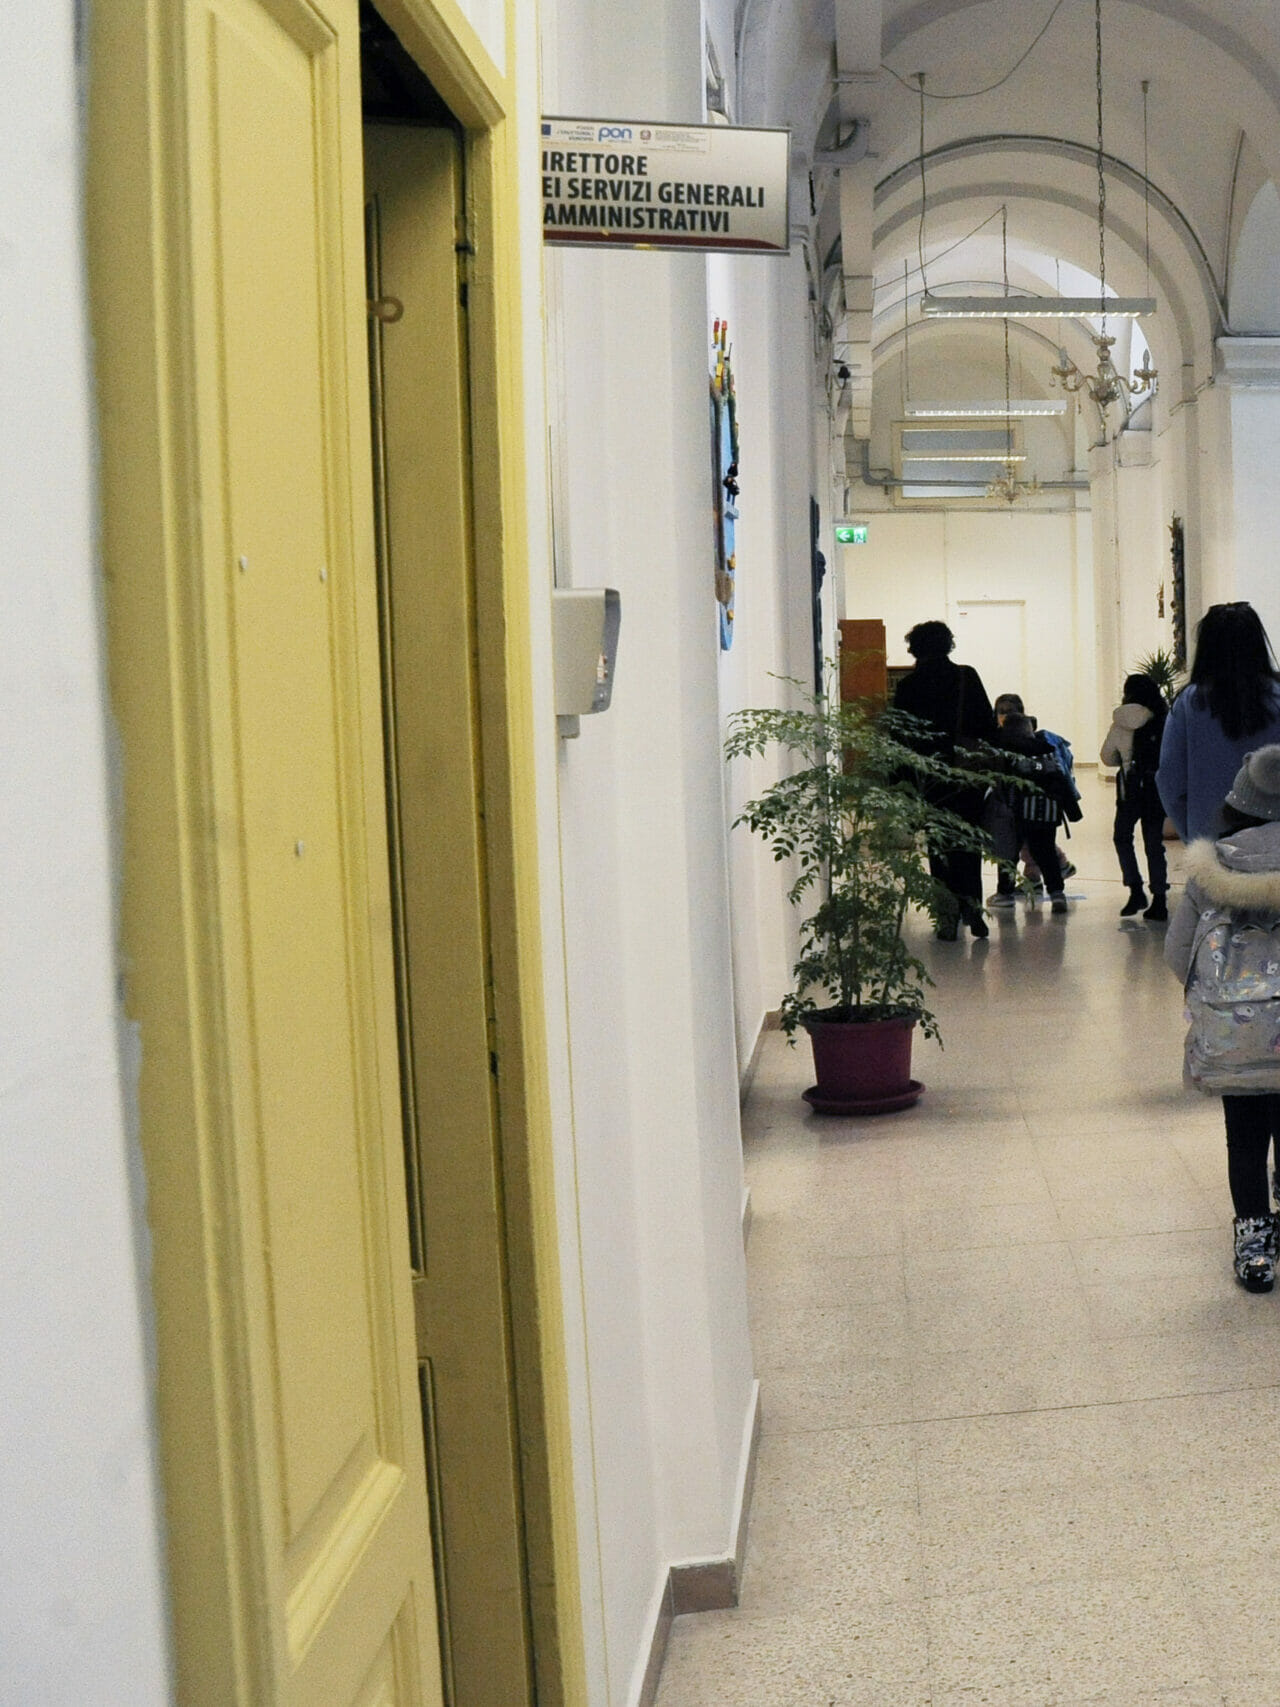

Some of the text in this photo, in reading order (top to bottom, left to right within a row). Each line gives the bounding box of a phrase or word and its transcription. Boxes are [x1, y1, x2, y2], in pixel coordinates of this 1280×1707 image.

[598, 127, 632, 142] pon
[542, 151, 648, 176] IRETTORE
[542, 176, 765, 208] EI SERVIZI GENERALI
[543, 203, 730, 233] AMMINISTRATIVI
